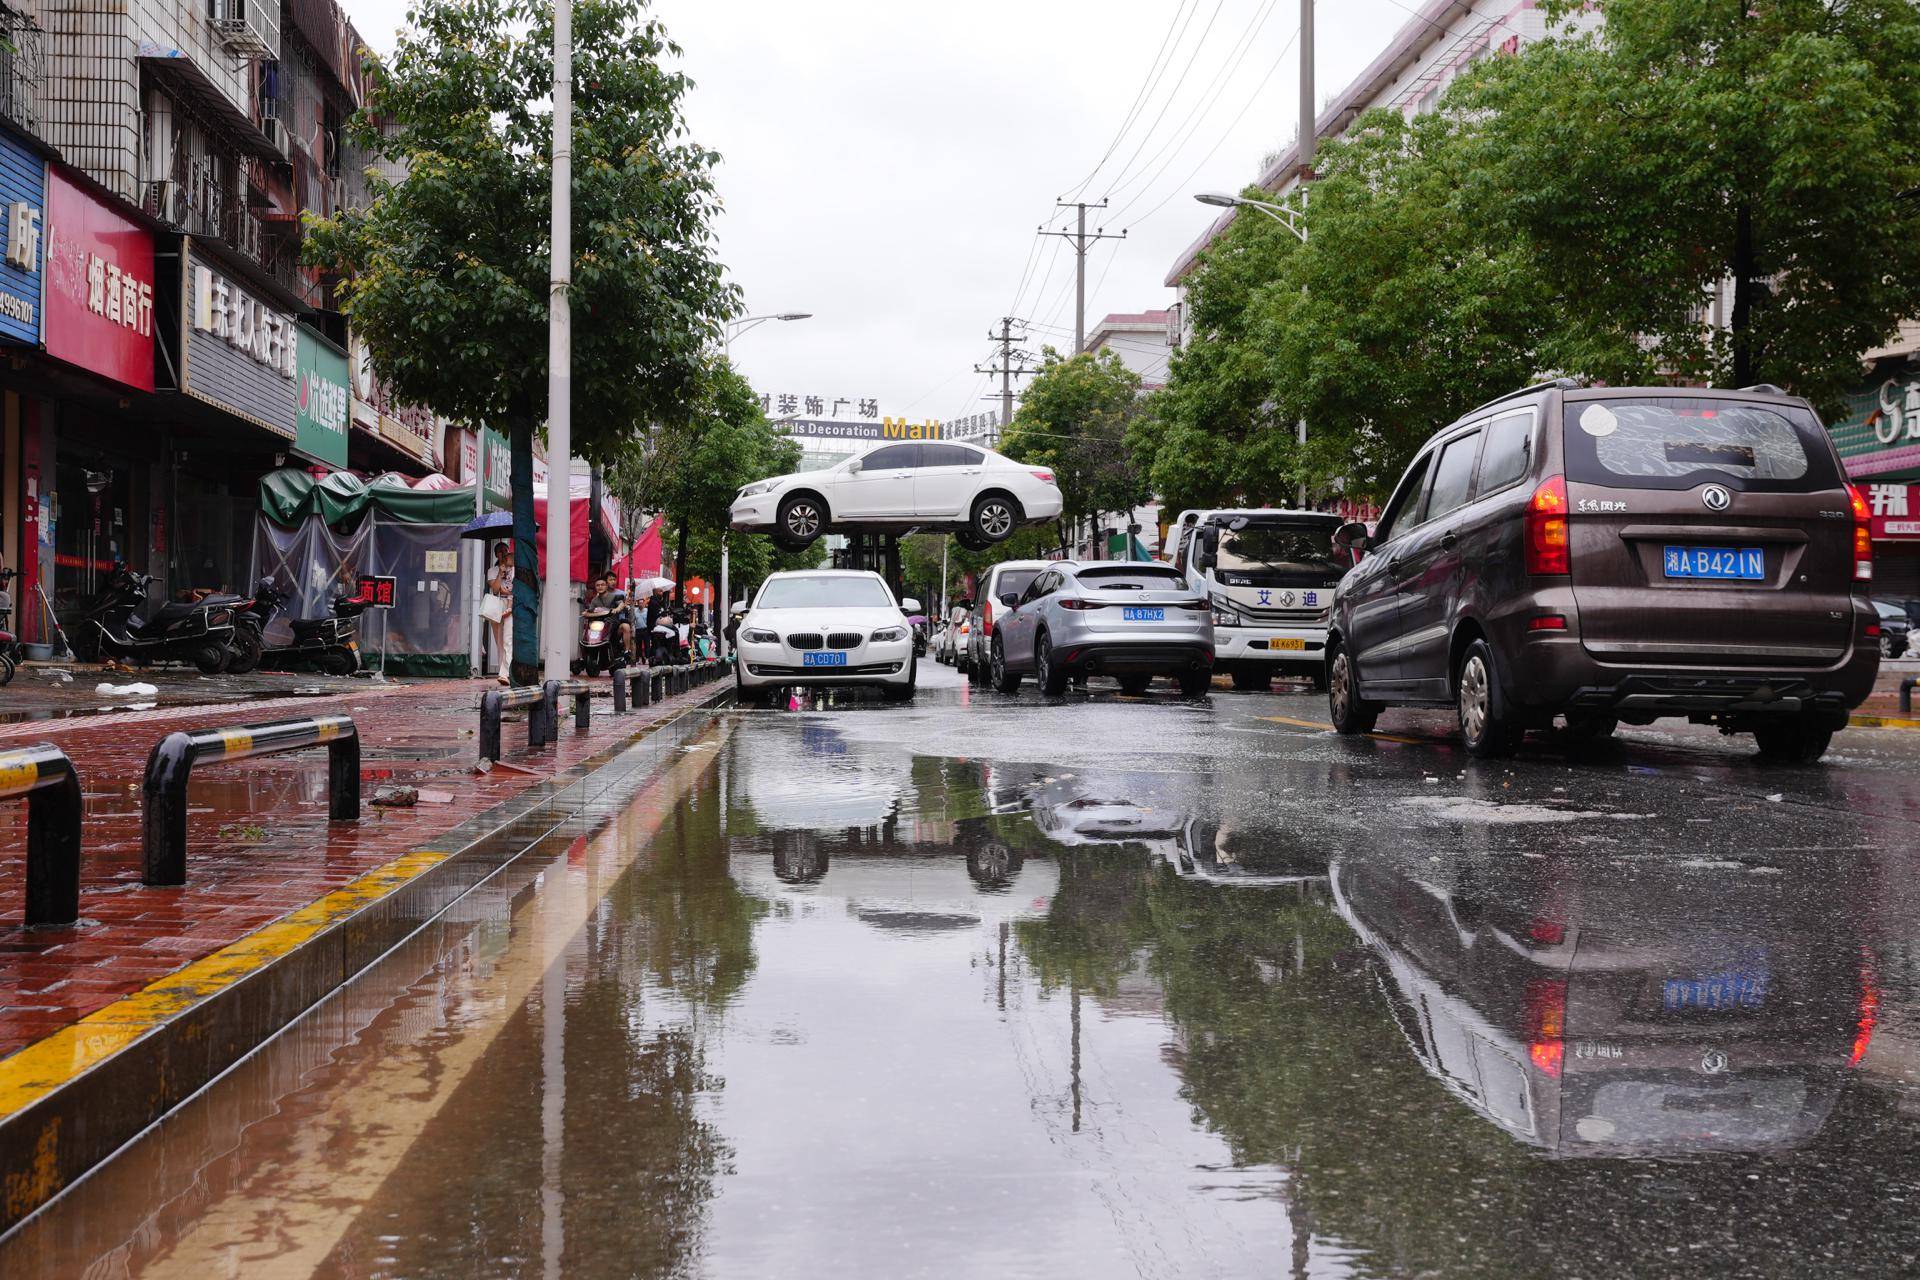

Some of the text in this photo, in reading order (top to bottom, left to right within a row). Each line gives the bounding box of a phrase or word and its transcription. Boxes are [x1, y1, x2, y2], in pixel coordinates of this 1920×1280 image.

[6, 202, 41, 272] 所
[86, 251, 153, 337] 烟酒商行
[808, 422, 878, 437] Decoration
[883, 416, 940, 440] Mall
[1869, 484, 1908, 516] 辣
[360, 580, 392, 604] 面馆
